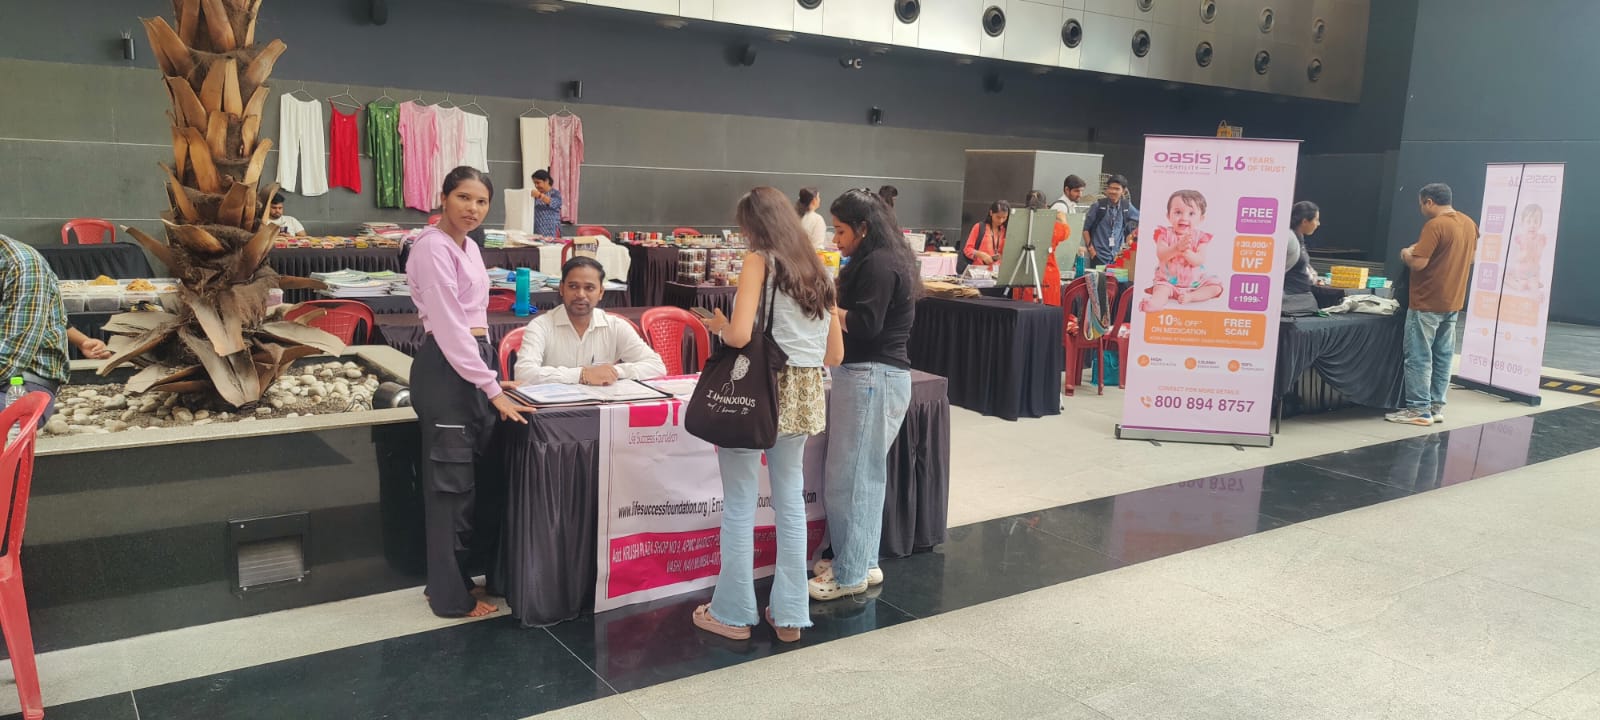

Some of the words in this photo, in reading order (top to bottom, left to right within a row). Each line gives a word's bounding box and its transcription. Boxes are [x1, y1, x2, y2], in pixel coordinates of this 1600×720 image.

[1223, 155, 1246, 171] 16
[1248, 156, 1275, 164] YEARS
[1241, 207, 1274, 218] FREE
[1241, 257, 1264, 269] IVF
[1240, 282, 1259, 294] IUI
[1158, 314, 1183, 326] 10%
[1223, 318, 1253, 328] FREE
[1163, 327, 1207, 336] MEDICATION
[1224, 328, 1249, 336] SCAN
[1154, 395, 1182, 409] 800
[1186, 397, 1213, 411] 894
[1218, 399, 1255, 413] 8757
